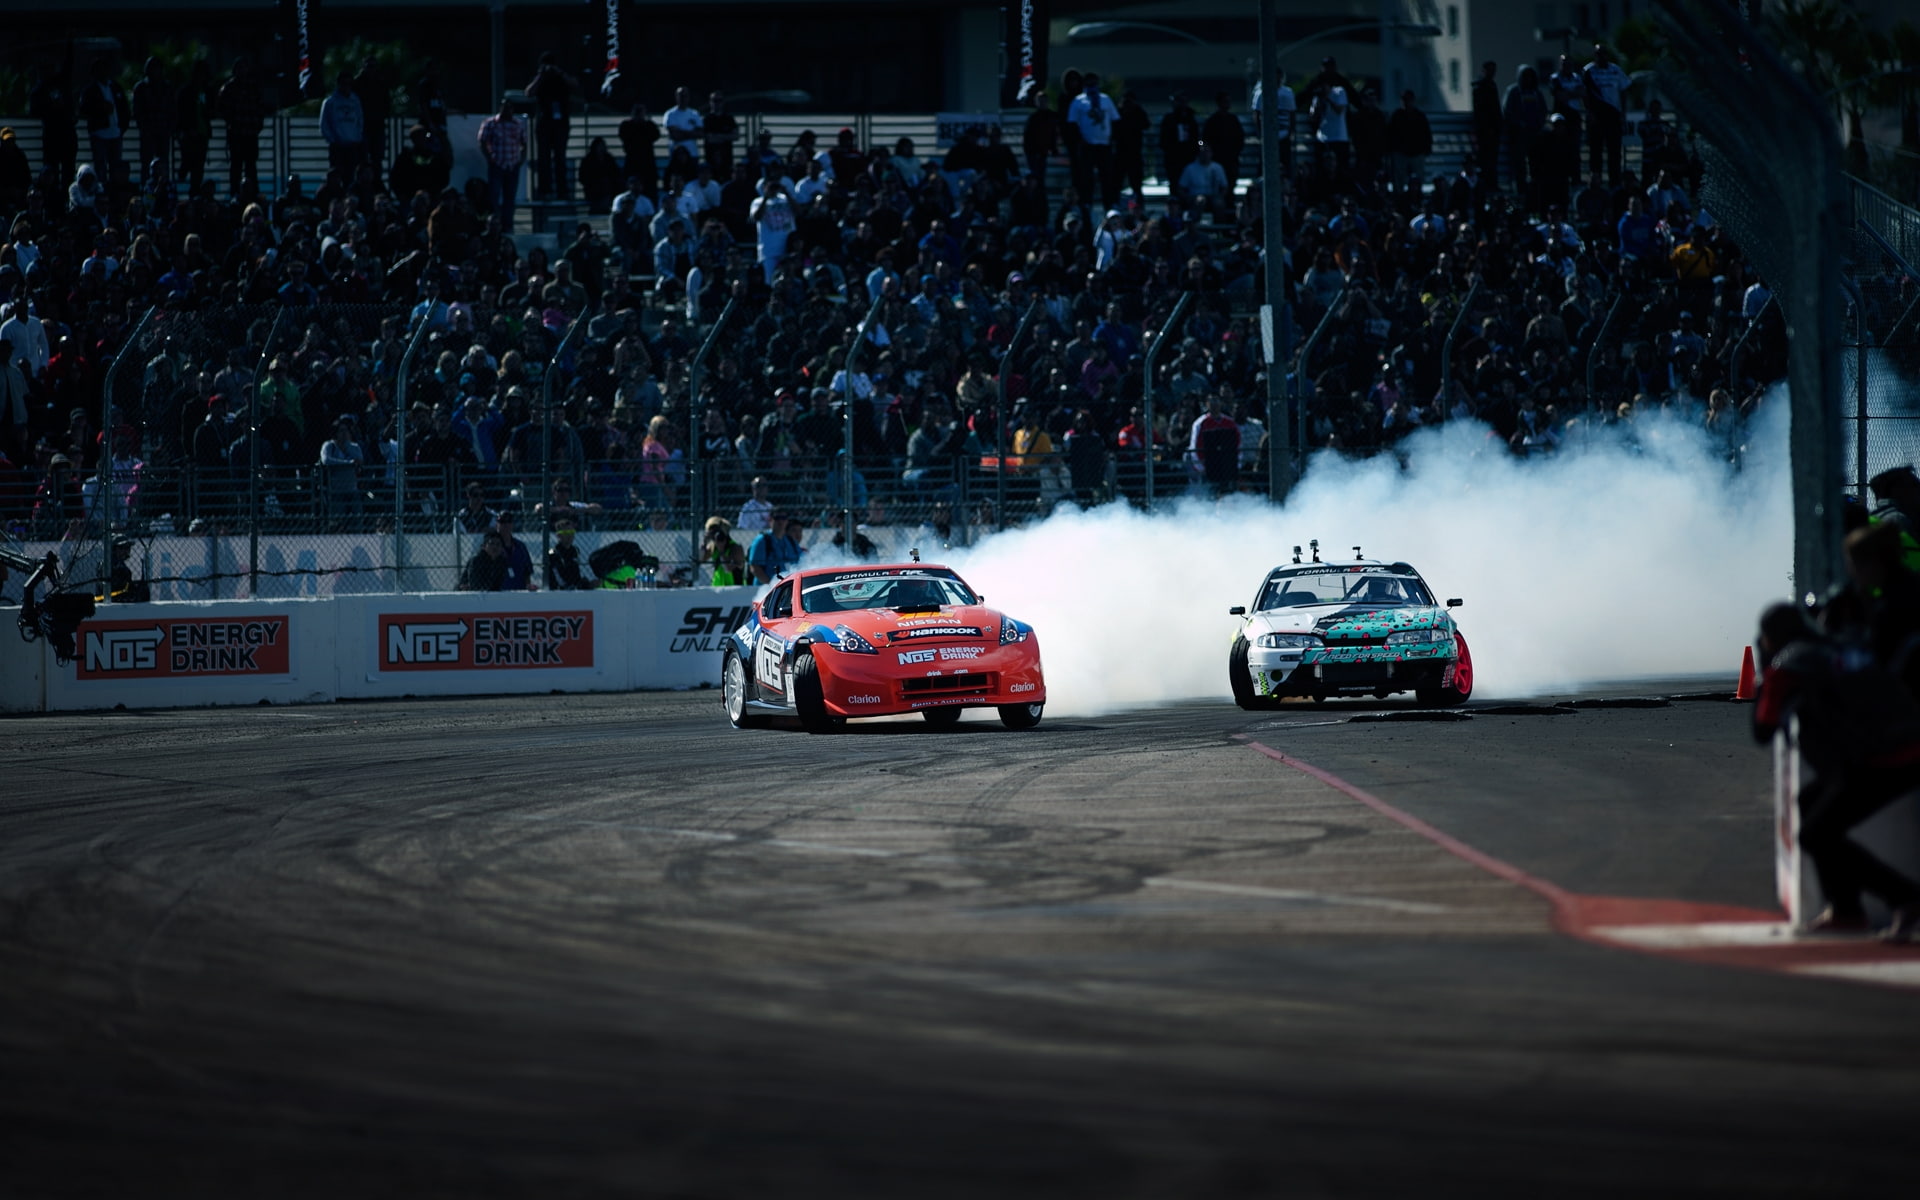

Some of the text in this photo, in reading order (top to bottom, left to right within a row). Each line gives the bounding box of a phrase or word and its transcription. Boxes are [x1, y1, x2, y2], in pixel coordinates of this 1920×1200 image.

[171, 622, 282, 646] ENERGY
[474, 617, 586, 643] ENERGY
[897, 619, 961, 627] NISSAN
[85, 626, 166, 672] NOS
[388, 618, 469, 664] NOS
[939, 646, 986, 654] ENERGY
[171, 646, 258, 672] DRINK
[474, 641, 563, 666] DRINK
[897, 648, 938, 665] NOS
[940, 652, 979, 661] DRINK
